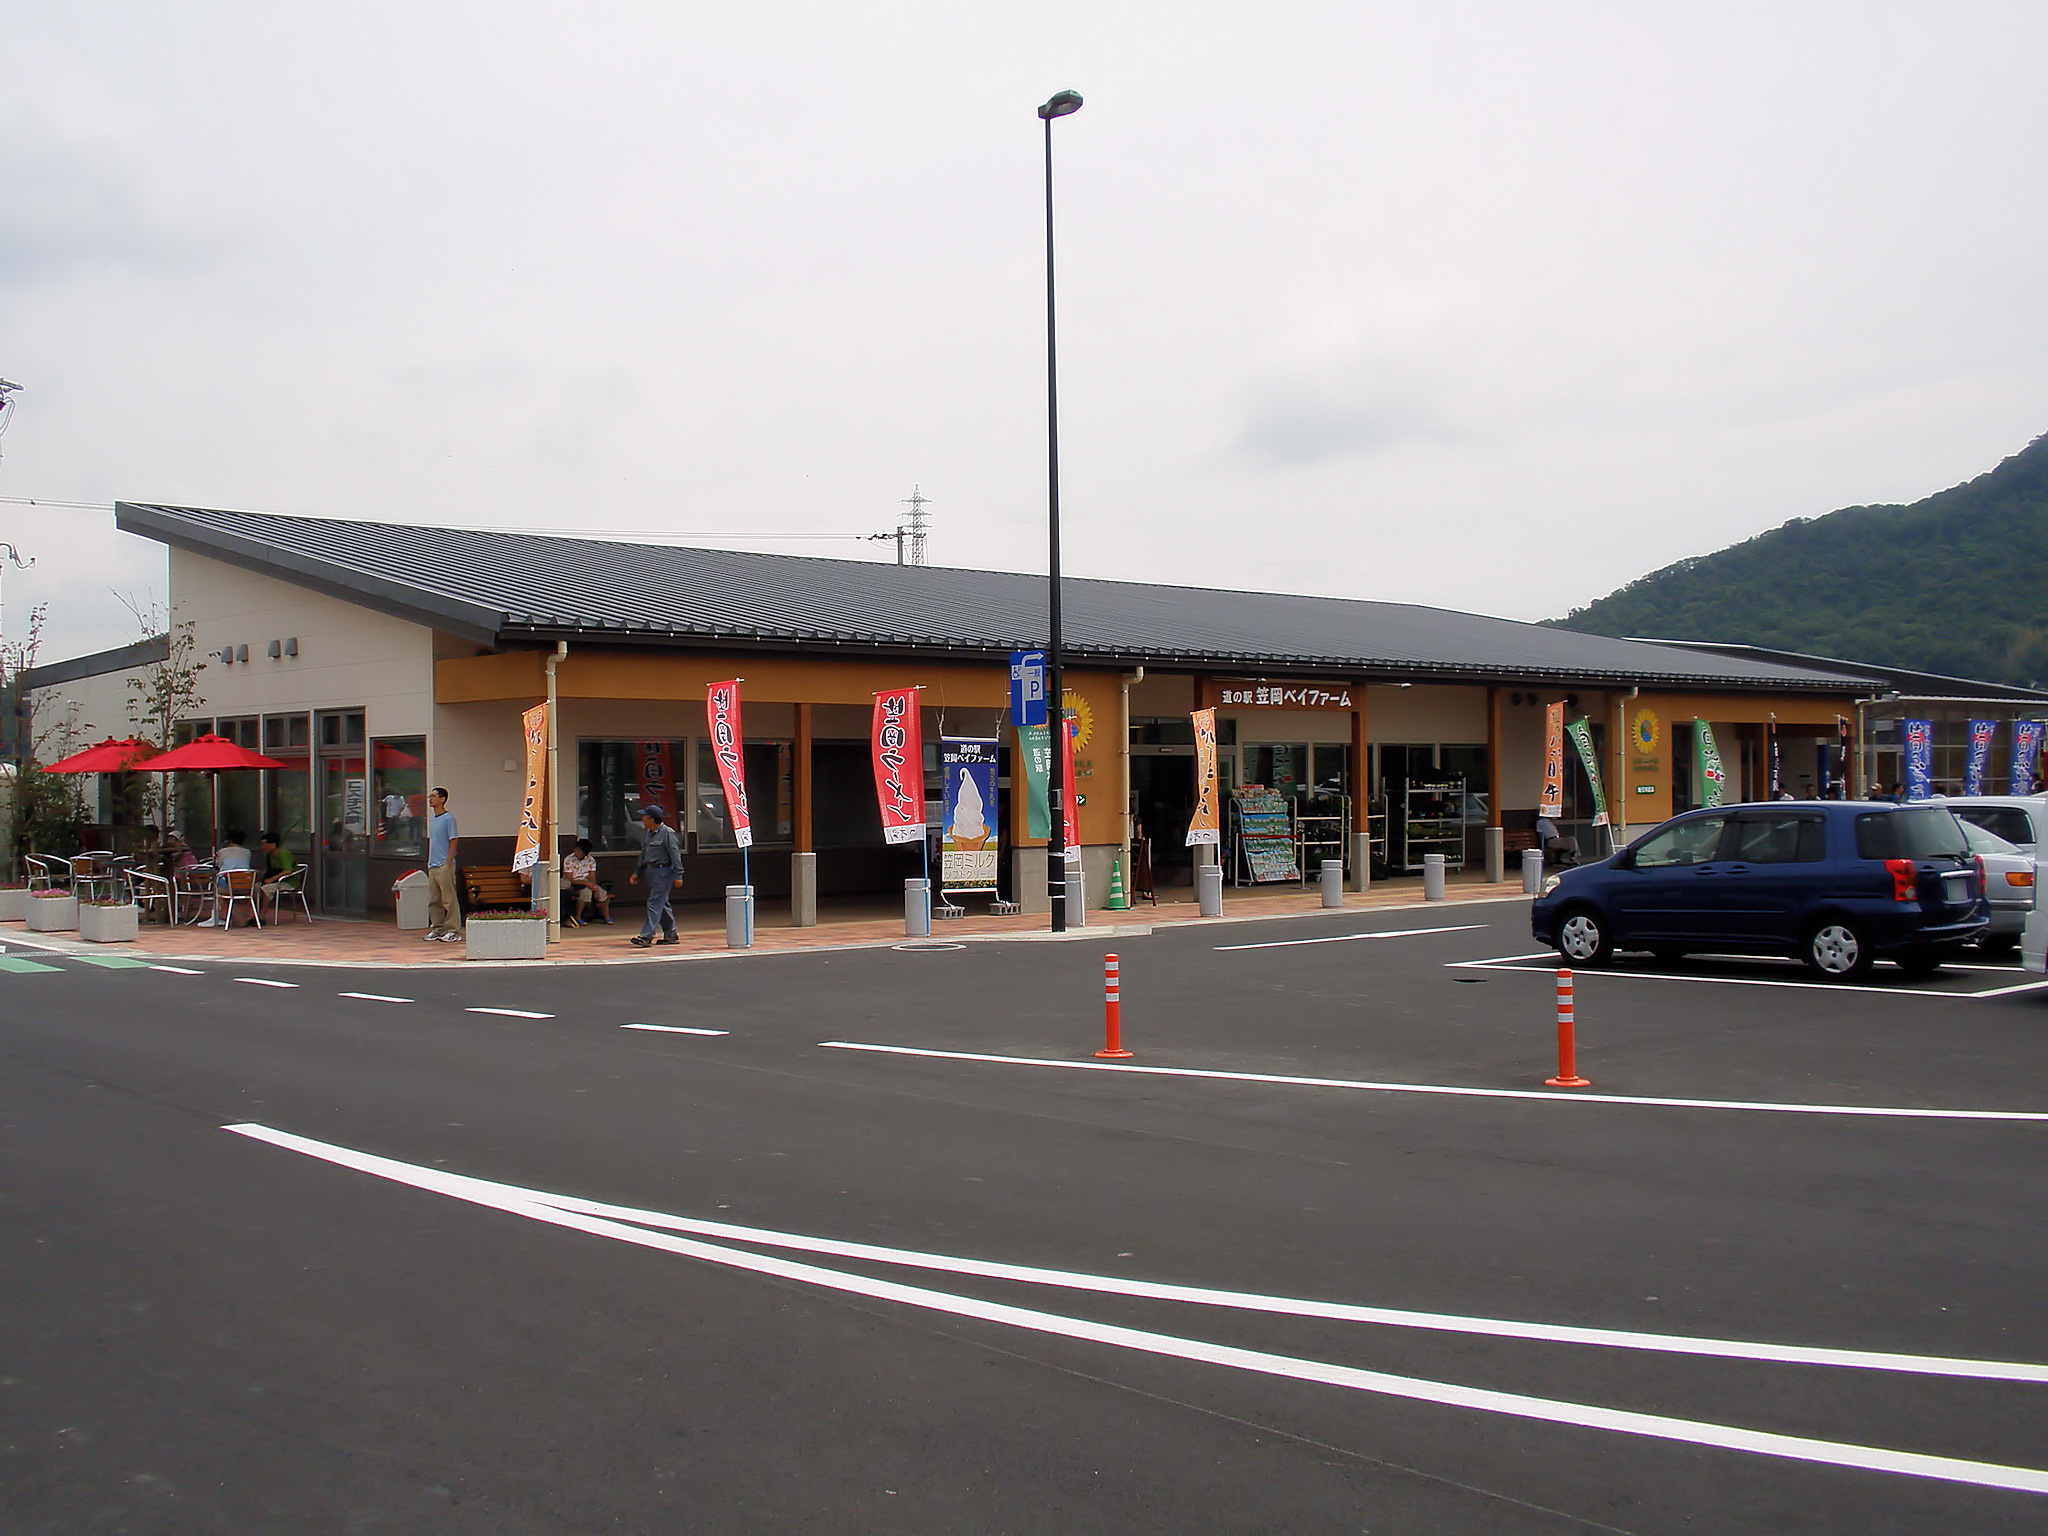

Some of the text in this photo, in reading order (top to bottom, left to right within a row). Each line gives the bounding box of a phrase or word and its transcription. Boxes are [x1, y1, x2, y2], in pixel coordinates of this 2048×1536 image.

[1027, 668, 1041, 677] 一般
[1030, 680, 1040, 698] P
[1222, 686, 1352, 707] 道の駅 笠岡ベイファーム
[960, 744, 981, 754] 道の駅
[943, 752, 997, 763] 笠岡ベイファーム
[944, 852, 995, 869] 笠岡ミルク
[944, 870, 993, 879] ソフトクリーム
